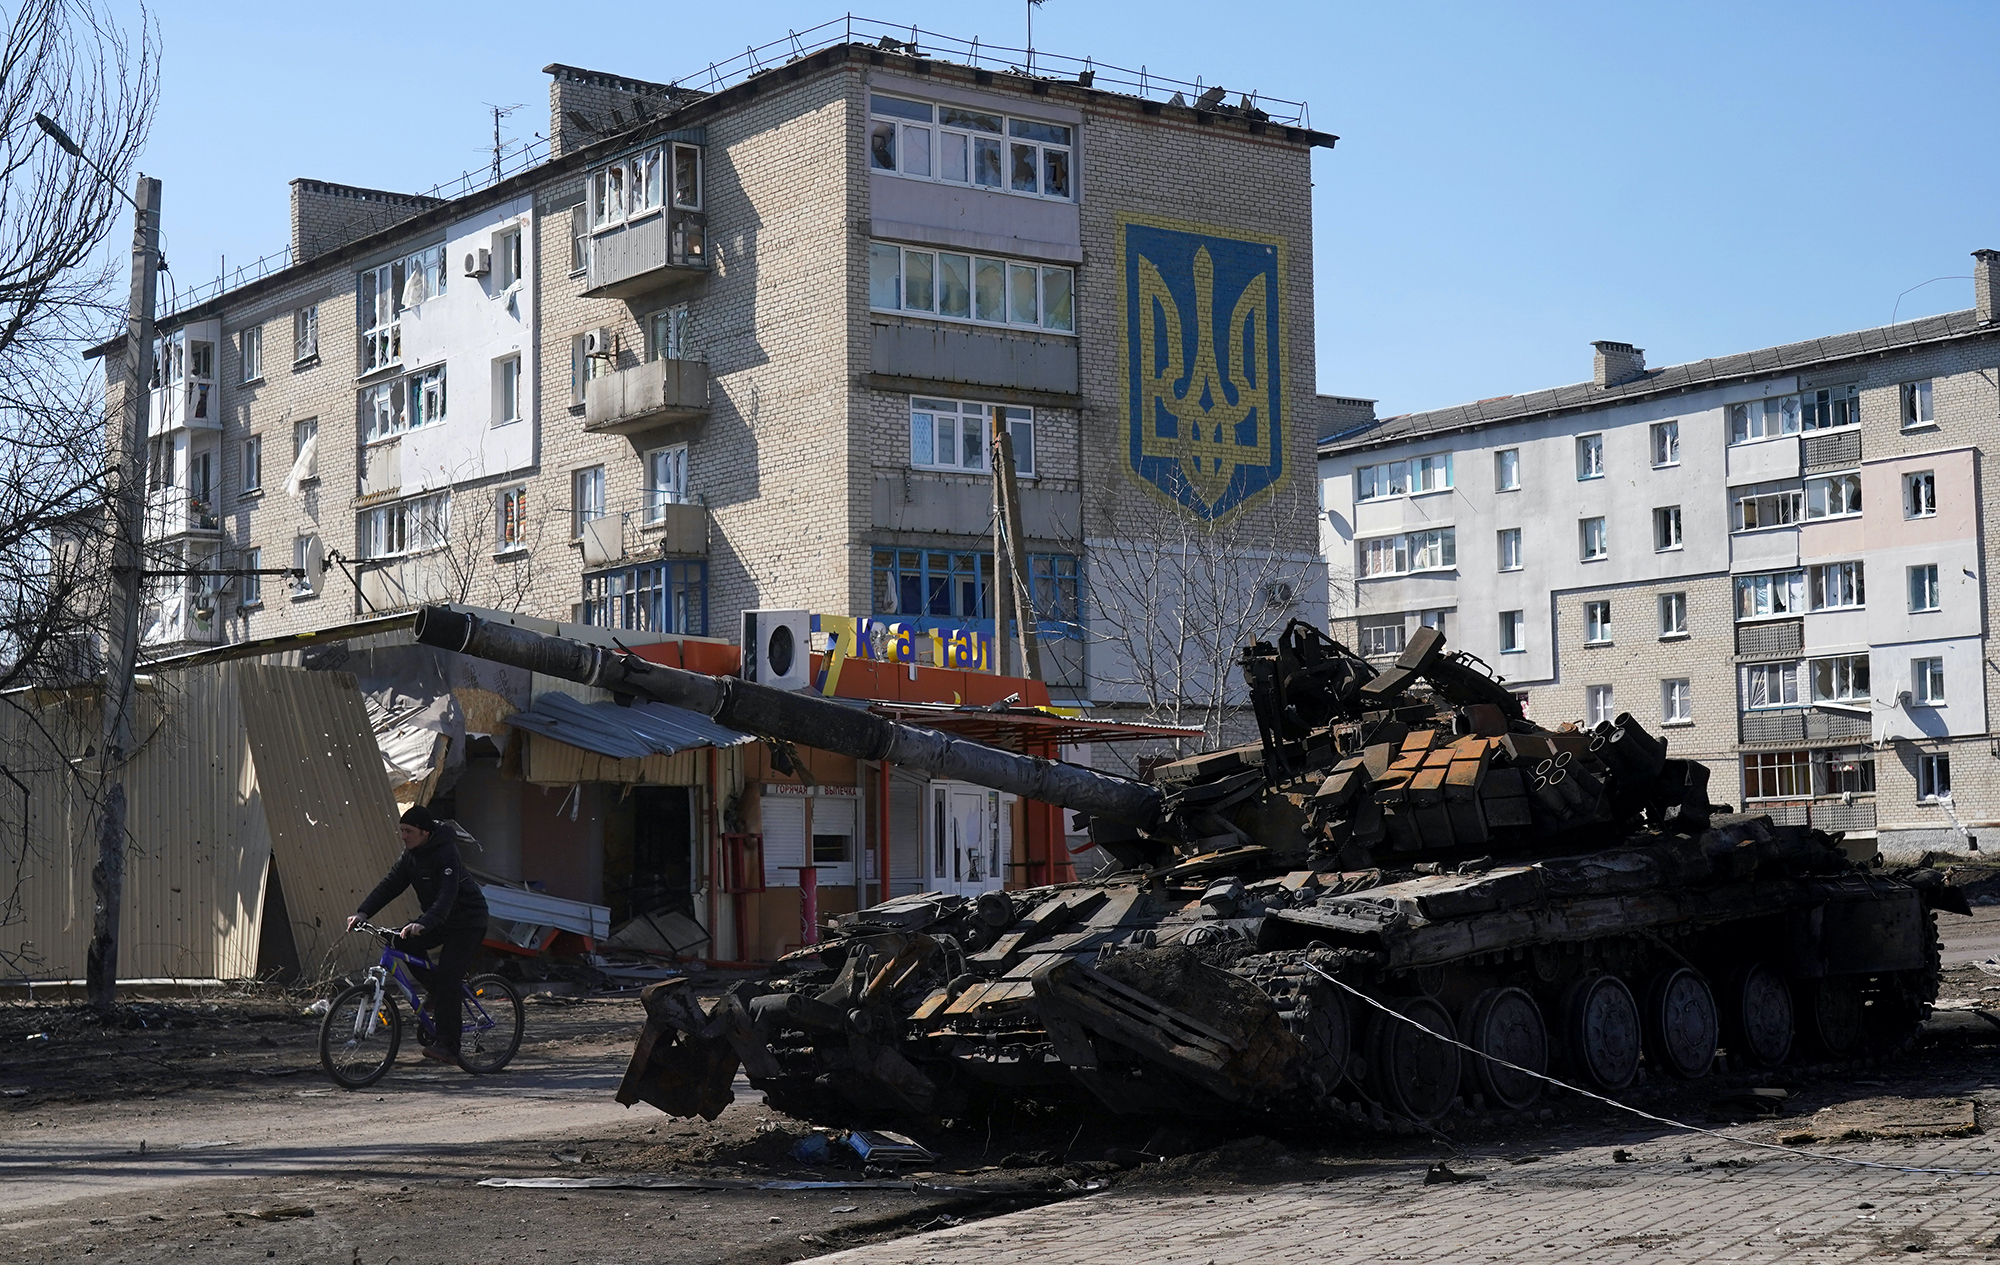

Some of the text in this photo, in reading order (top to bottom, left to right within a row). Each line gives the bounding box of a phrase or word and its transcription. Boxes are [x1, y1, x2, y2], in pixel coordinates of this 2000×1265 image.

[811, 614, 851, 696] 7
[775, 784, 857, 796] ГОРЯЧАЯ ВЫПЕЧКА
